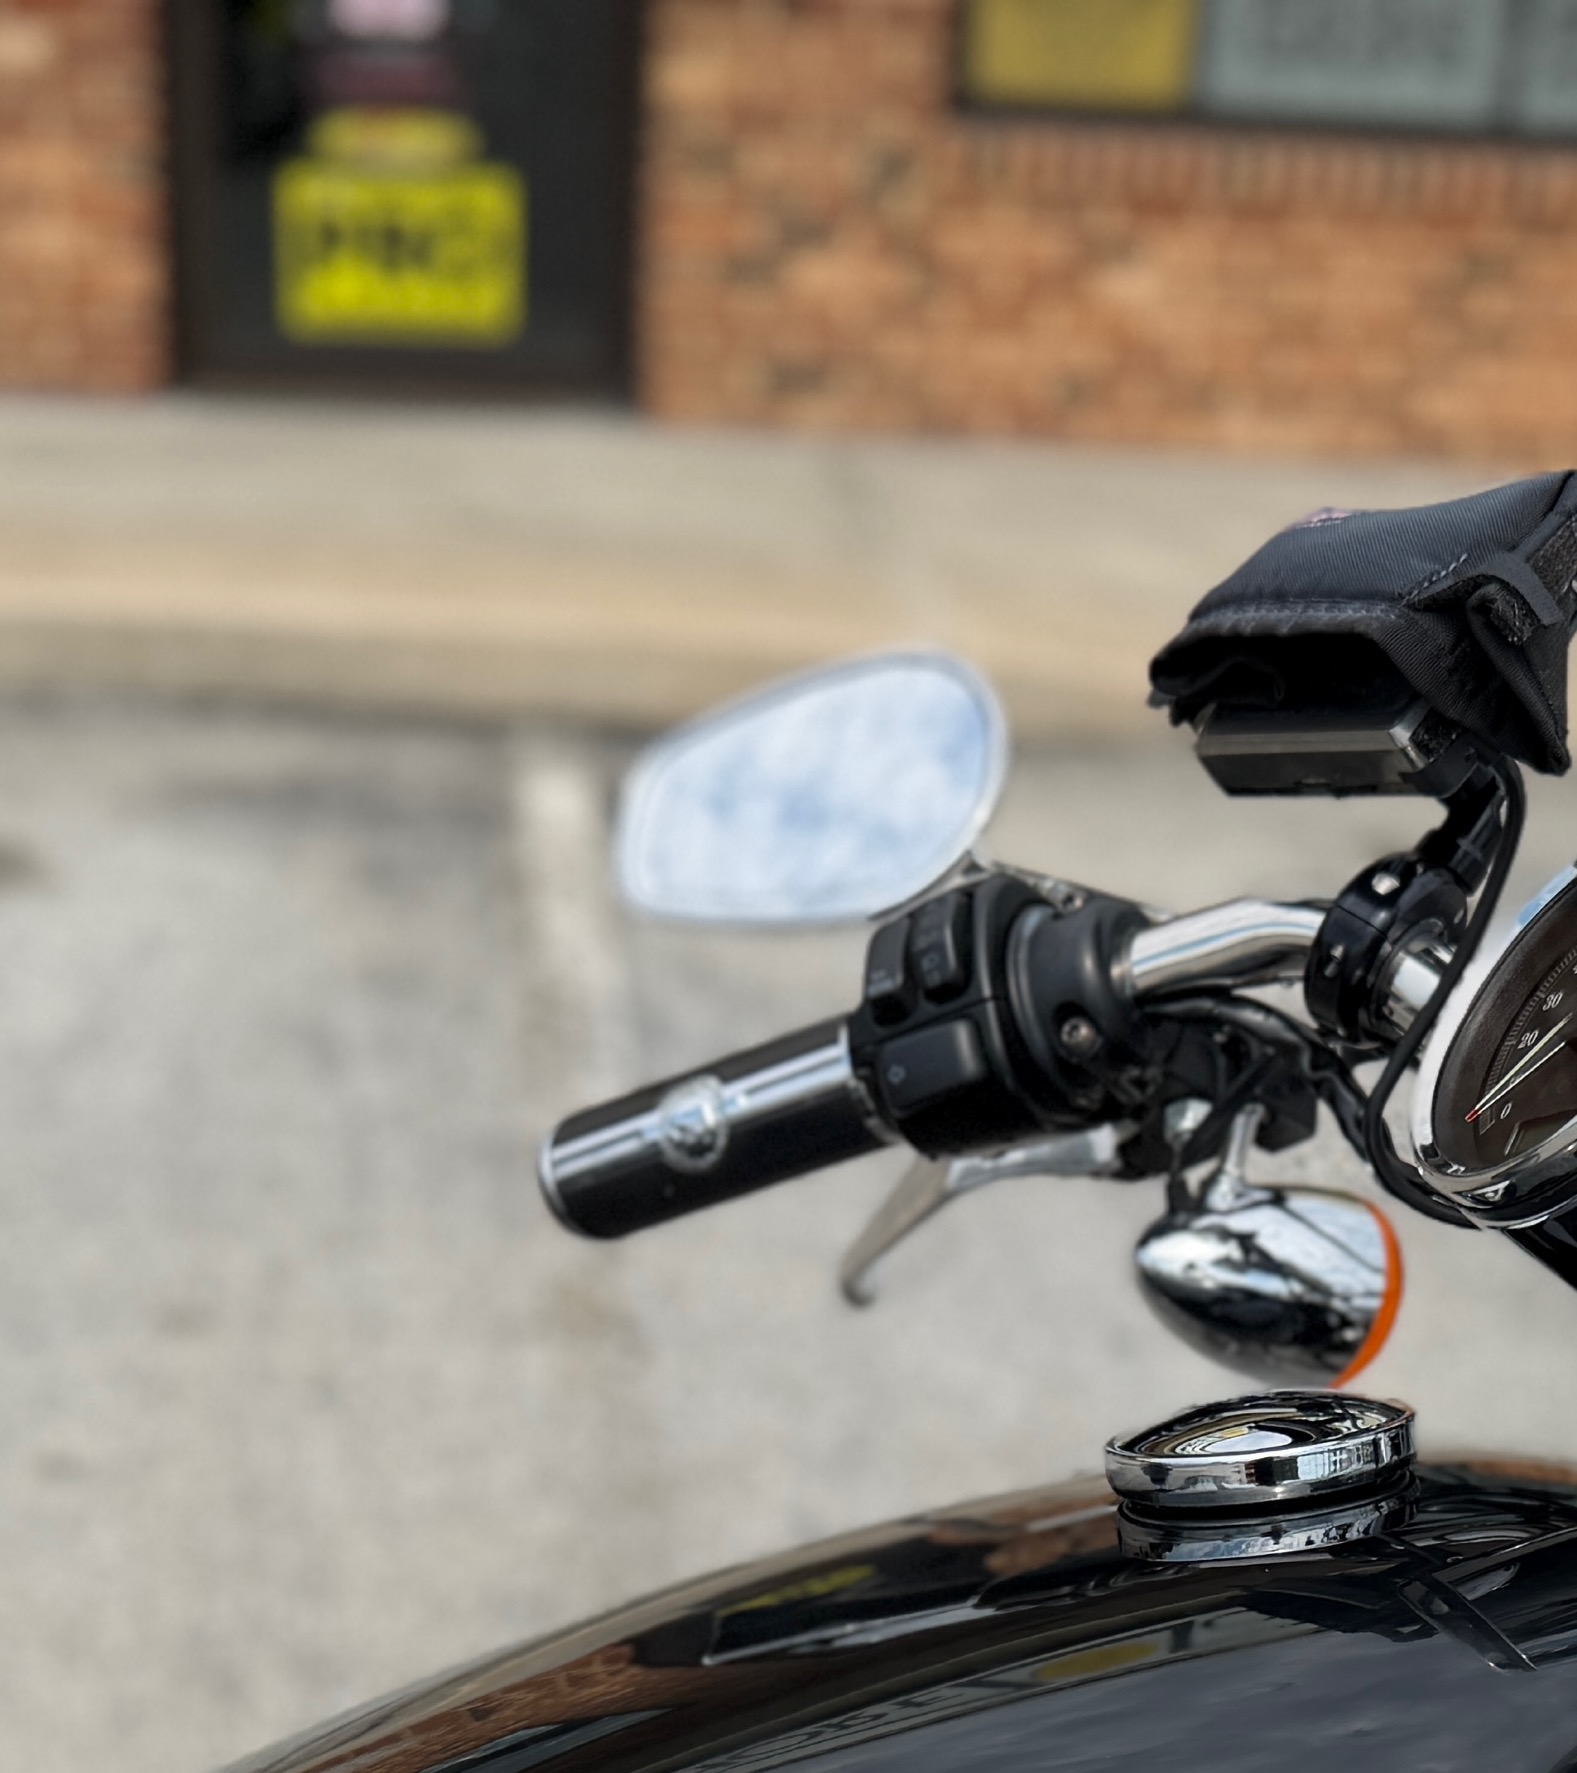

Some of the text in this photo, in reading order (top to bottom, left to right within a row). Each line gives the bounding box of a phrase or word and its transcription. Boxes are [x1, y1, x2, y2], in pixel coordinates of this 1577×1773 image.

[1542, 991, 1563, 1011] 30
[1517, 1029, 1539, 1049] 20
[1500, 1102, 1512, 1120] 0
